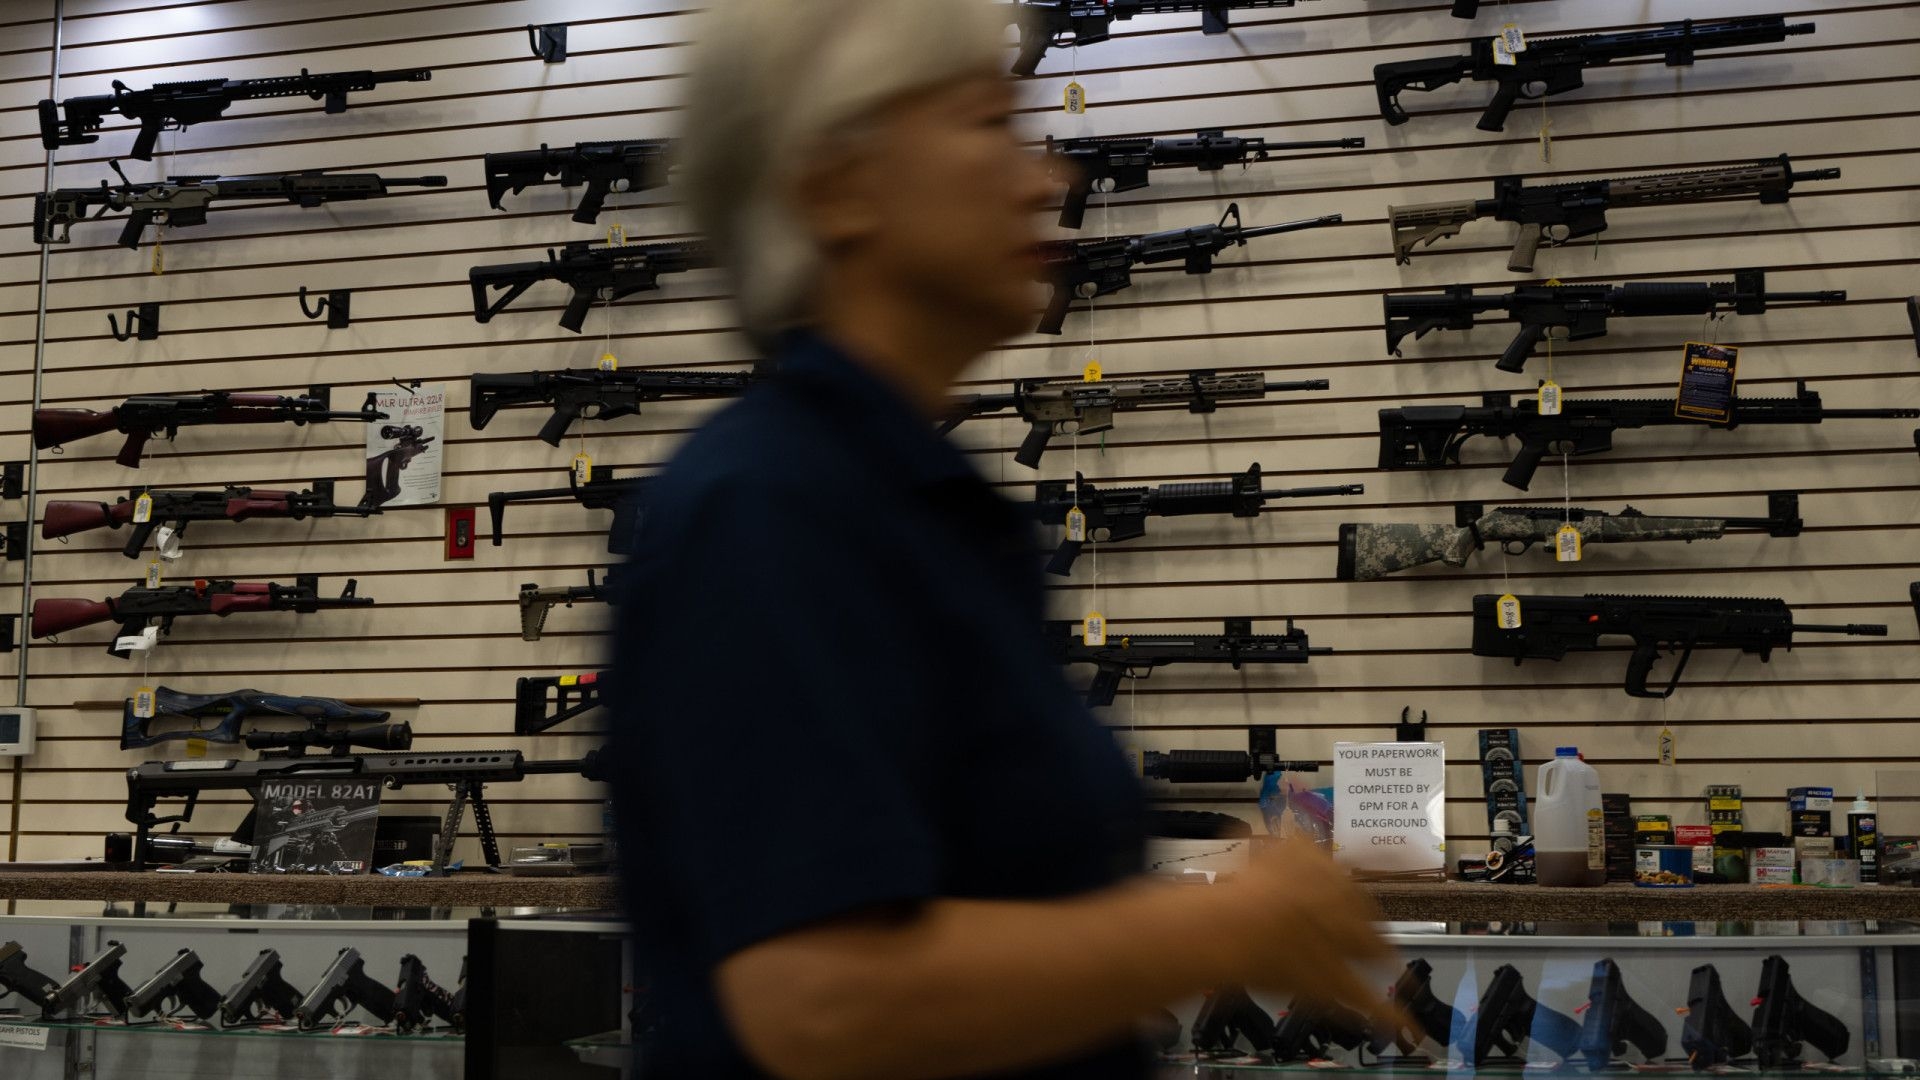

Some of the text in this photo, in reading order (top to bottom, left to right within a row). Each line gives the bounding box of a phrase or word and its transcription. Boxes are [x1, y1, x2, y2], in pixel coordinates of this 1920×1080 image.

[1690, 357, 1728, 368] WINDHAM
[375, 393, 443, 408] MLR ULTRA 22LR
[1339, 748, 1439, 759] YOUR PAPERWORK
[1662, 736, 1673, 761] A-36
[1365, 767, 1413, 777] MUST BE
[264, 784, 376, 800] MODEL 82A1
[1348, 784, 1430, 794] COMPLETED BY
[1359, 801, 1419, 811] 6PM FOR A
[1351, 818, 1428, 828] BACKGROUND
[1371, 835, 1407, 845] CHECK
[16, 1027, 41, 1036] PISTOLS
